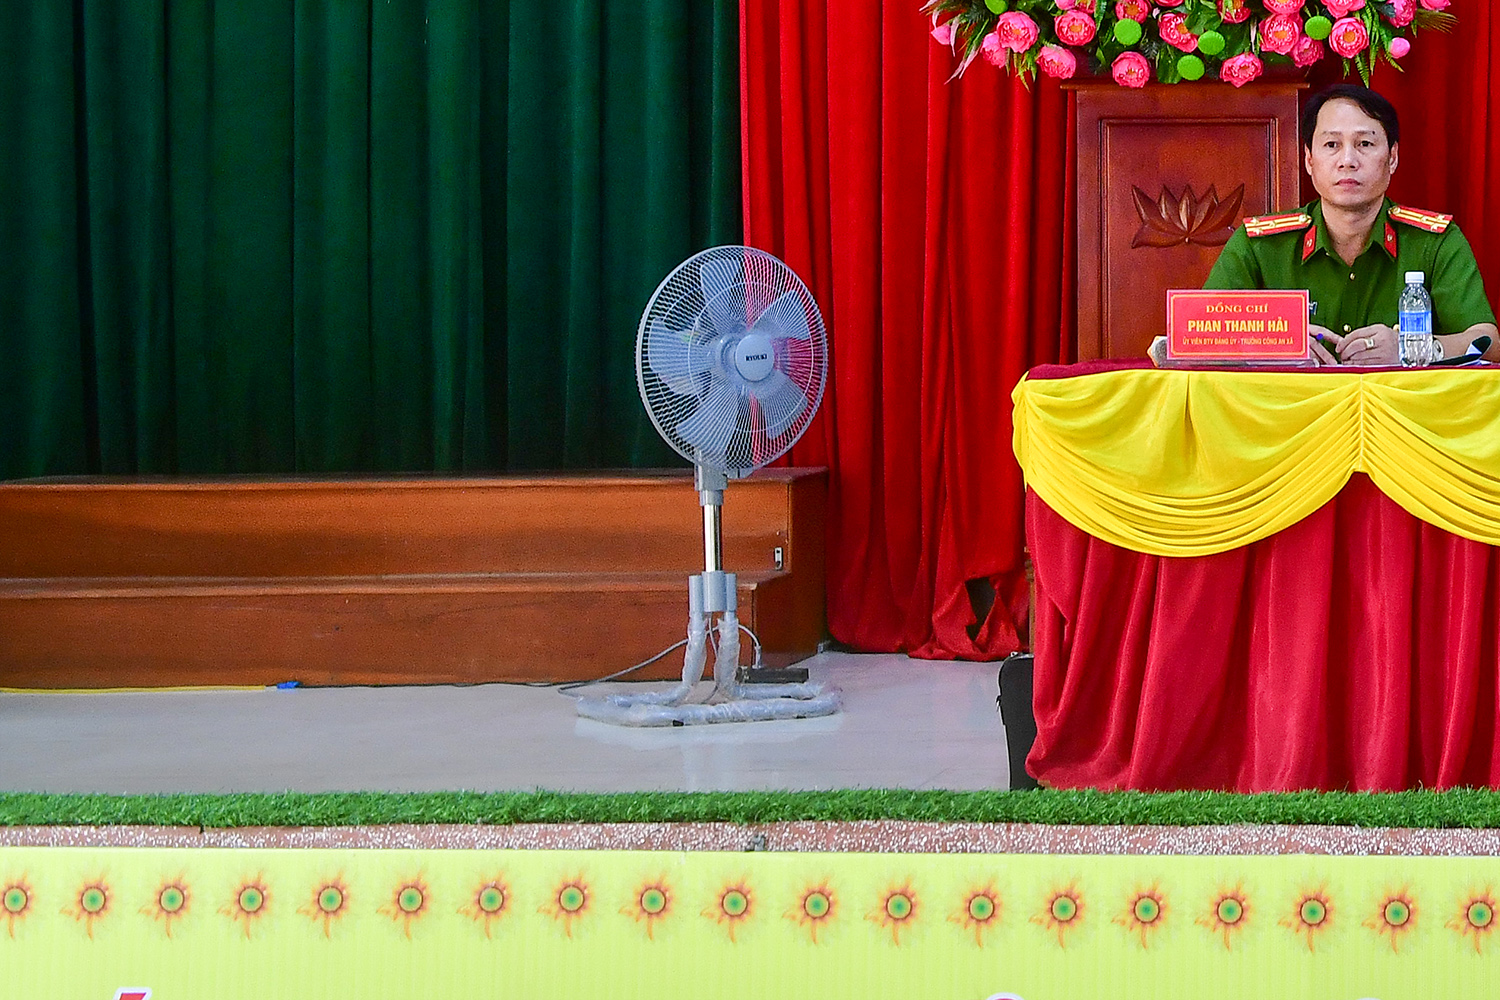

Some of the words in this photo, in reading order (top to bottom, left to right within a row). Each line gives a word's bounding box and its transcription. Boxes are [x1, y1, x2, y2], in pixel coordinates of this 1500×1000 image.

[1206, 302, 1242, 313] ĐỒNG
[1246, 303, 1269, 313] CHÍ
[1187, 320, 1221, 332] PHAN
[1225, 320, 1264, 332] THANH
[1268, 316, 1288, 332] HẢI
